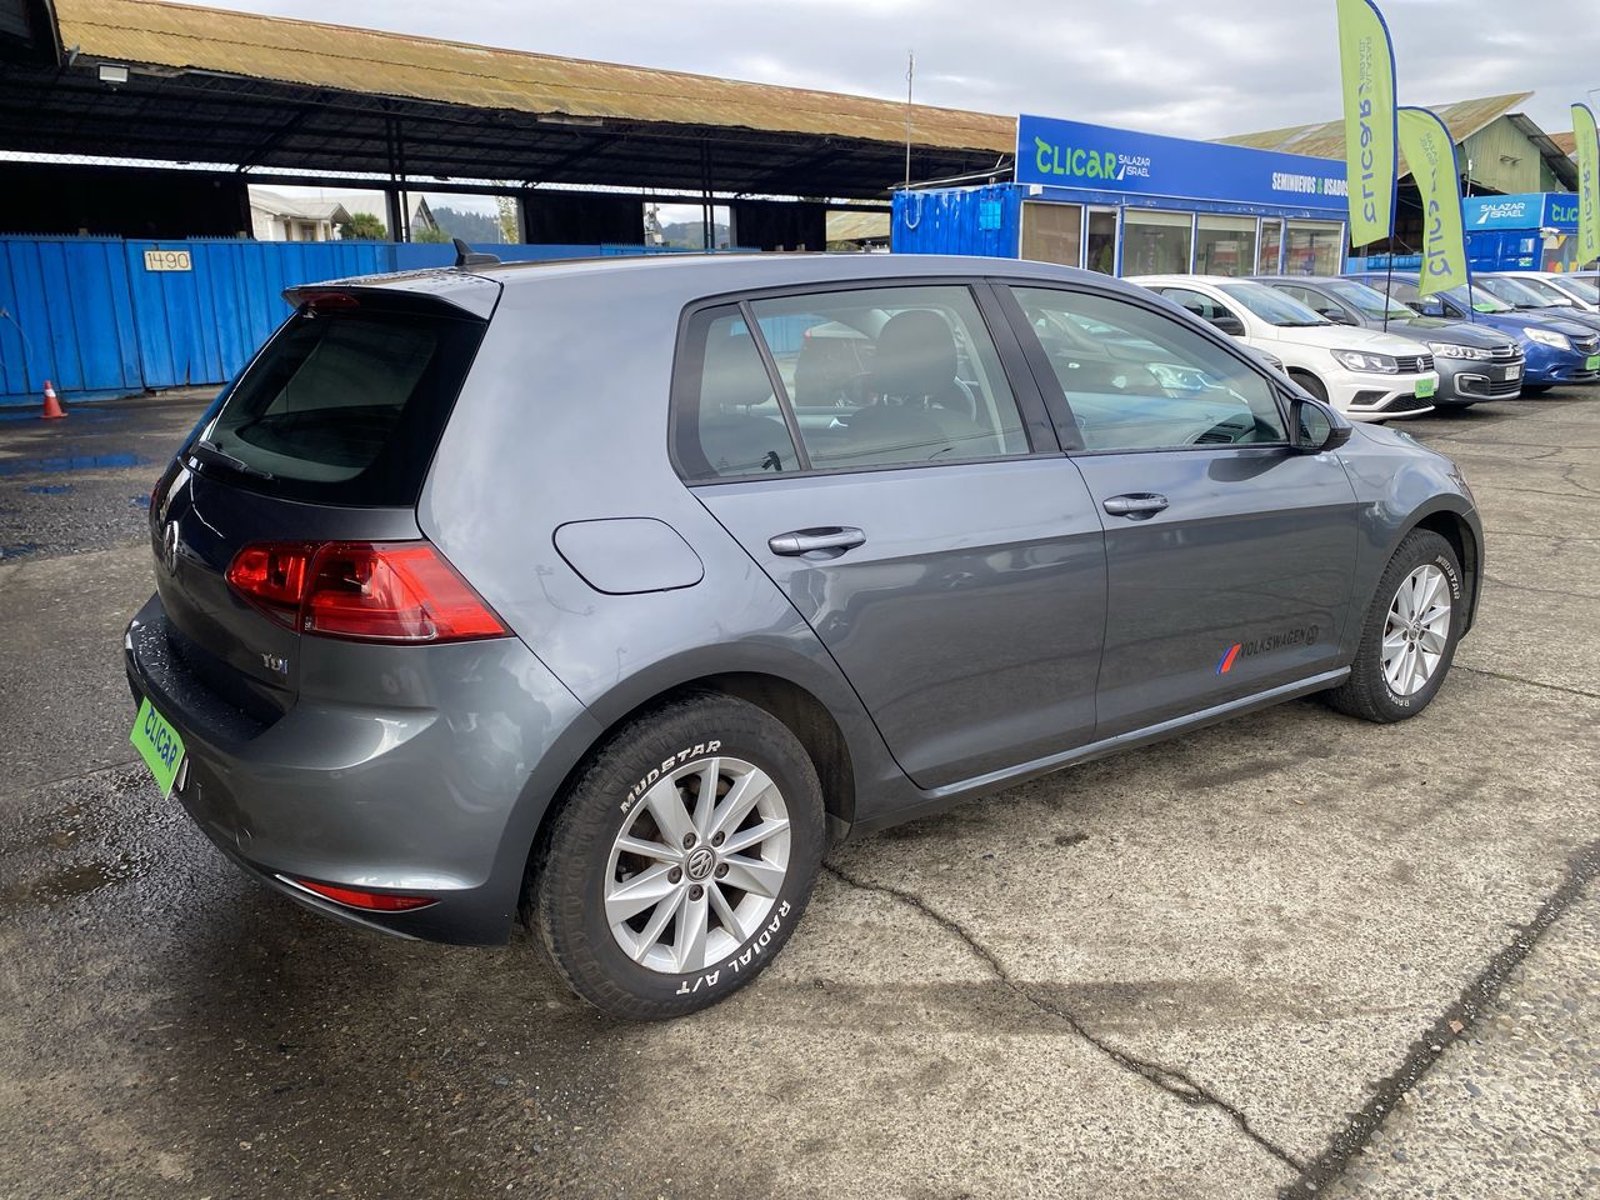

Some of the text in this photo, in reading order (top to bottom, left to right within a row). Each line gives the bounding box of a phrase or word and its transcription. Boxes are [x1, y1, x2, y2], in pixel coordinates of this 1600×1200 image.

[1118, 154, 1151, 167] SALAZAR
[1125, 165, 1151, 178] ISRAEL
[1272, 171, 1316, 194] SEMINUEVOS
[1480, 202, 1526, 211] SALAZAR
[1488, 210, 1525, 219] ISRAEL
[147, 252, 190, 270] 1490
[1240, 627, 1307, 658] VOLKSWAGEN
[620, 739, 722, 815] MUDSTAR
[676, 899, 791, 996] RADIAL A/T
